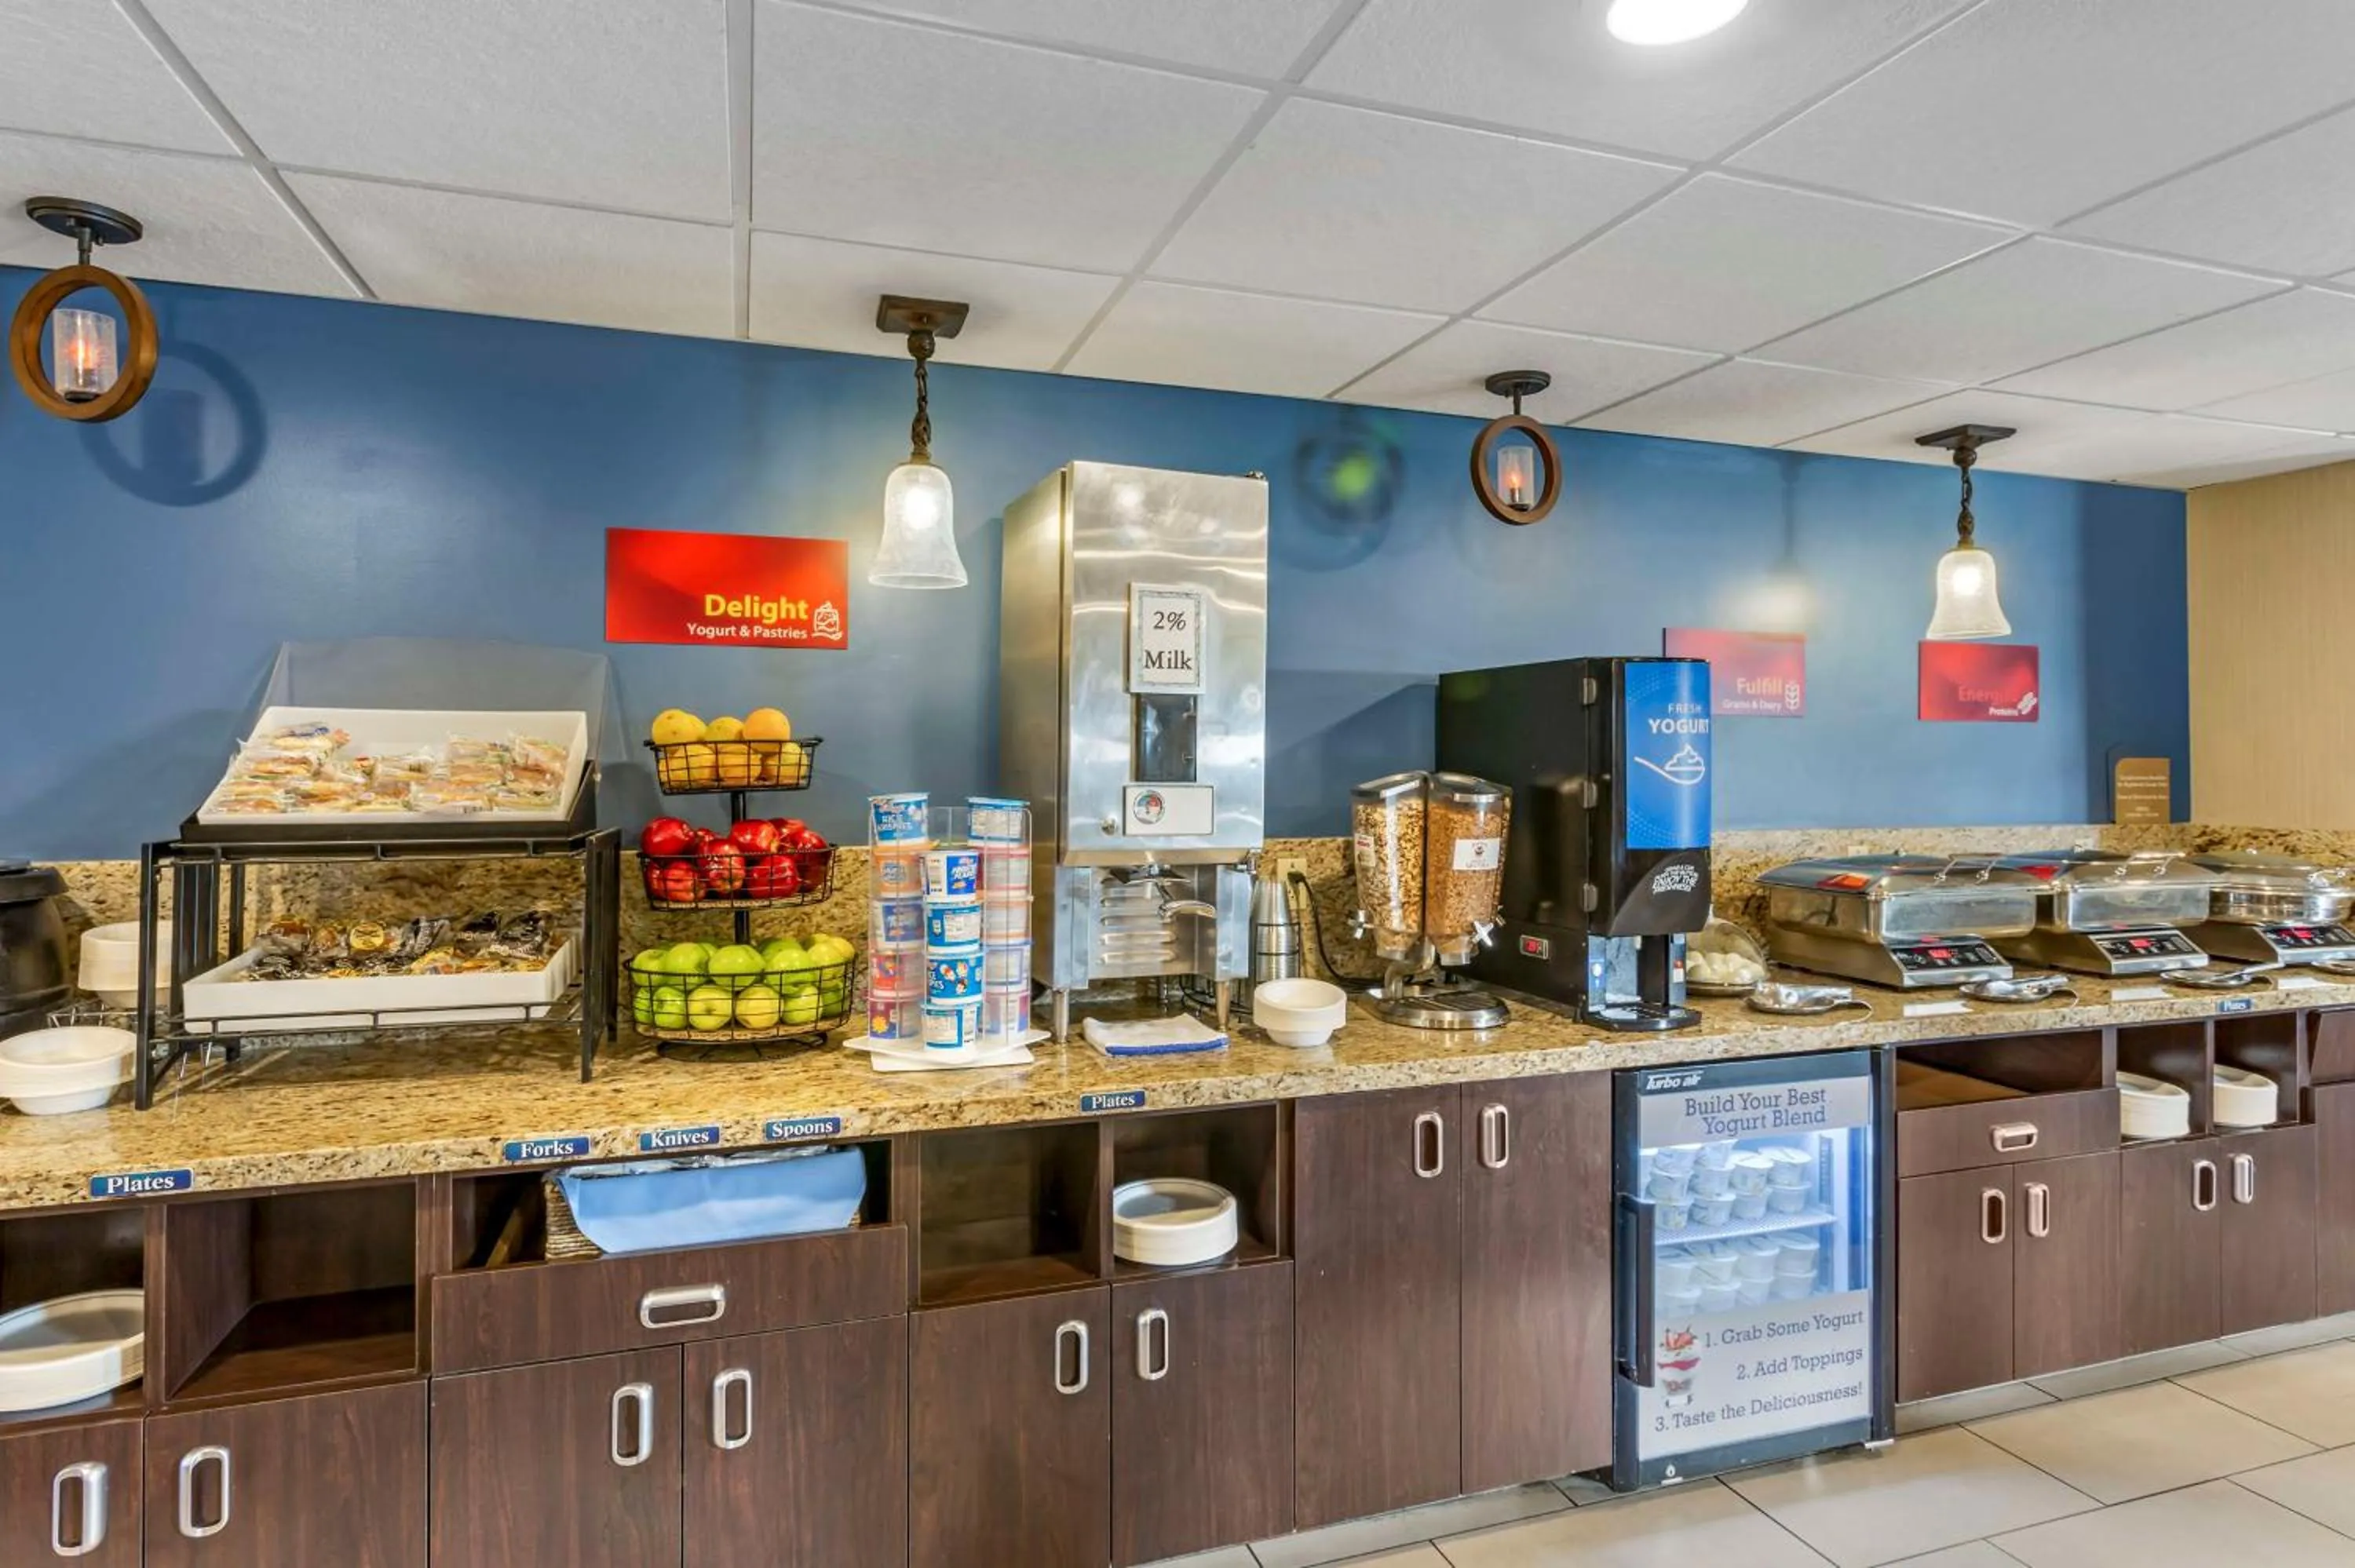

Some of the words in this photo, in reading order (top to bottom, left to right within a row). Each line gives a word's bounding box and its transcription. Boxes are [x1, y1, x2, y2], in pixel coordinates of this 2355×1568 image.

[704, 593, 809, 624] Delight
[1153, 611, 1186, 631] 2%
[686, 622, 736, 640] Yogurt
[739, 625, 750, 638] &
[753, 625, 808, 640] Pastries
[1144, 650, 1192, 670] Milk
[1668, 703, 1702, 715] FRESH
[1645, 1072, 1681, 1090] Turbo
[1092, 1095, 1135, 1109] Plates
[1685, 1095, 1735, 1117] Build
[1738, 1092, 1783, 1111] Your
[1787, 1088, 1827, 1105] Best
[772, 1120, 833, 1138] Spoons
[1702, 1114, 1767, 1137] Yogurt
[1772, 1106, 1827, 1126] Blend
[651, 1129, 710, 1148] Knives
[520, 1142, 574, 1158] Forks
[107, 1176, 175, 1194] Plates
[1704, 1333, 1718, 1348] 1.
[1721, 1326, 1762, 1345] Grab
[1766, 1320, 1810, 1338] Some
[1813, 1310, 1864, 1331] Yogurt
[1736, 1365, 1751, 1380] 2.
[1754, 1358, 1788, 1377] Add
[1791, 1348, 1864, 1372] Toppings
[1654, 1417, 1670, 1432] 3.
[1671, 1410, 1716, 1429] Taste
[1721, 1404, 1746, 1420] the
[1750, 1381, 1864, 1416] Deliciousness!
